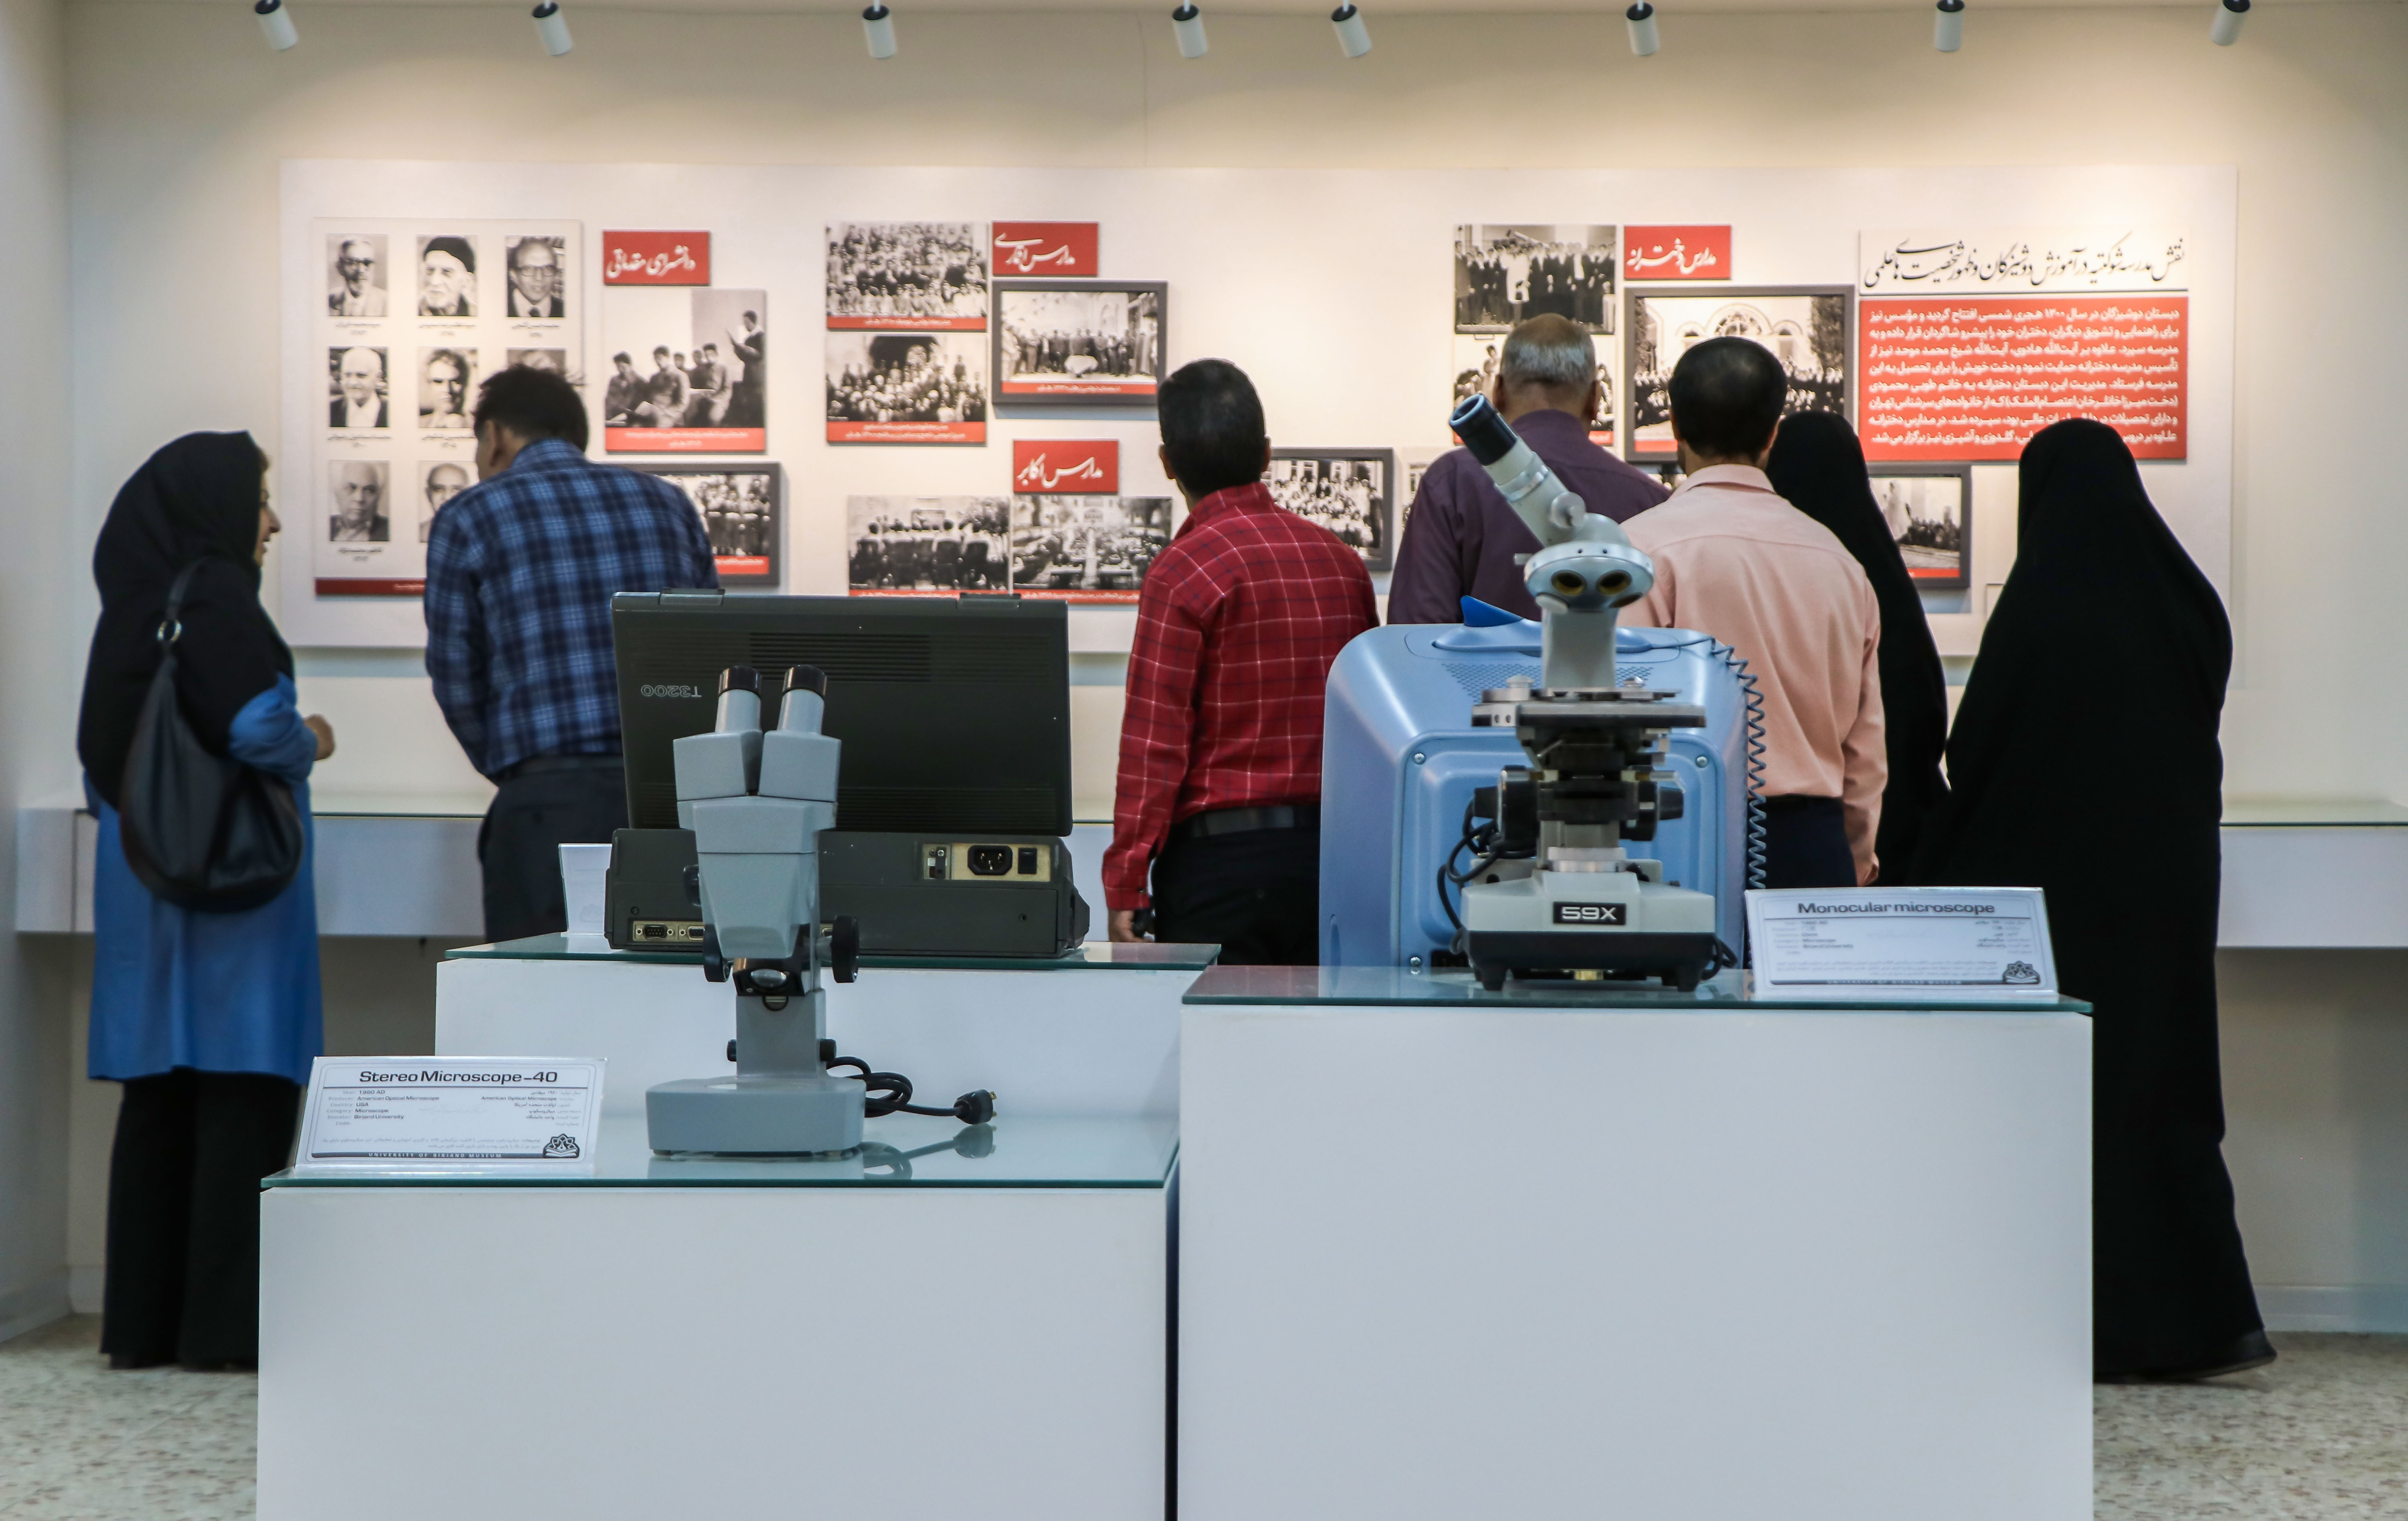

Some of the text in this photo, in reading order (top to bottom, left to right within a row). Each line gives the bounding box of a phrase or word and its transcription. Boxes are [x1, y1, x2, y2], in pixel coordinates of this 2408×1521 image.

[1626, 237, 1717, 275] مدارس دخترانه
[2150, 237, 2184, 282] نقش
[2031, 246, 2087, 286] آموزش
[1869, 309, 1883, 324] نیز
[1918, 312, 1926, 324] و
[1926, 307, 1951, 323] گردید
[1977, 308, 2012, 323] شمسی
[2013, 309, 2044, 323] هجری
[2066, 307, 2088, 322] سال
[2088, 310, 2099, 322] در
[2100, 306, 2144, 322] دوشیزگان
[2144, 307, 2180, 322] دبستان
[1996, 326, 2015, 340] خود
[2015, 325, 2048, 340] دختران
[2113, 328, 2120, 340] و
[2159, 324, 2180, 340] برای
[1921, 346, 1950, 356] محمد
[2146, 345, 2180, 357] مدرسه
[2111, 362, 2143, 374] مدرسه
[2012, 377, 2050, 392] دبستان
[2050, 377, 2069, 393] این
[2145, 379, 2179, 392] مدرسه
[1041, 456, 1104, 489] مدارس
[641, 685, 702, 697] T3200
[1562, 906, 1617, 920] 59X
[1798, 901, 1995, 915] Monocular microscope
[359, 1070, 418, 1083] Stereo
